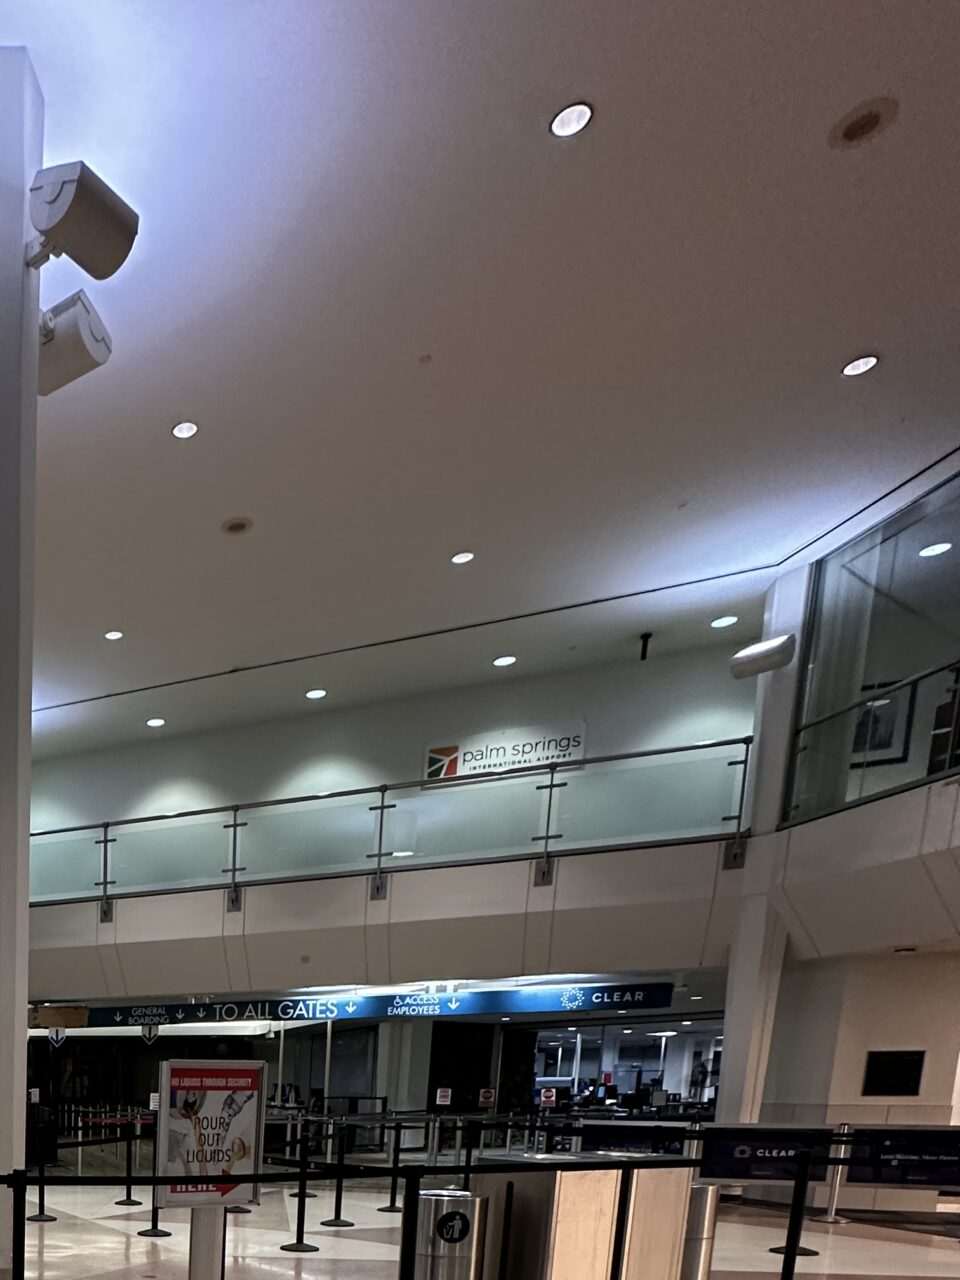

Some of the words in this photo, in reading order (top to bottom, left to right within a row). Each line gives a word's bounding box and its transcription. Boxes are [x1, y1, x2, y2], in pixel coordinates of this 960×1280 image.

[463, 745, 506, 765] palm
[512, 735, 581, 758] springs
[469, 757, 532, 771] INTERNATIONAL
[536, 752, 572, 762] AIRPORT
[404, 995, 439, 1005] ACCESS
[591, 991, 644, 1003] CLEAR
[131, 1006, 167, 1016] GENERAL
[213, 1003, 238, 1021] TO
[243, 1002, 273, 1019] ALL
[278, 1000, 338, 1020] GATES
[387, 1005, 440, 1016] EMPLOYEES
[128, 1015, 170, 1025] BOARDING
[194, 1116, 226, 1131] POUR
[200, 1133, 221, 1147] OUT
[186, 1149, 232, 1163] LIQUIDS
[756, 1149, 795, 1157] CLEAR
